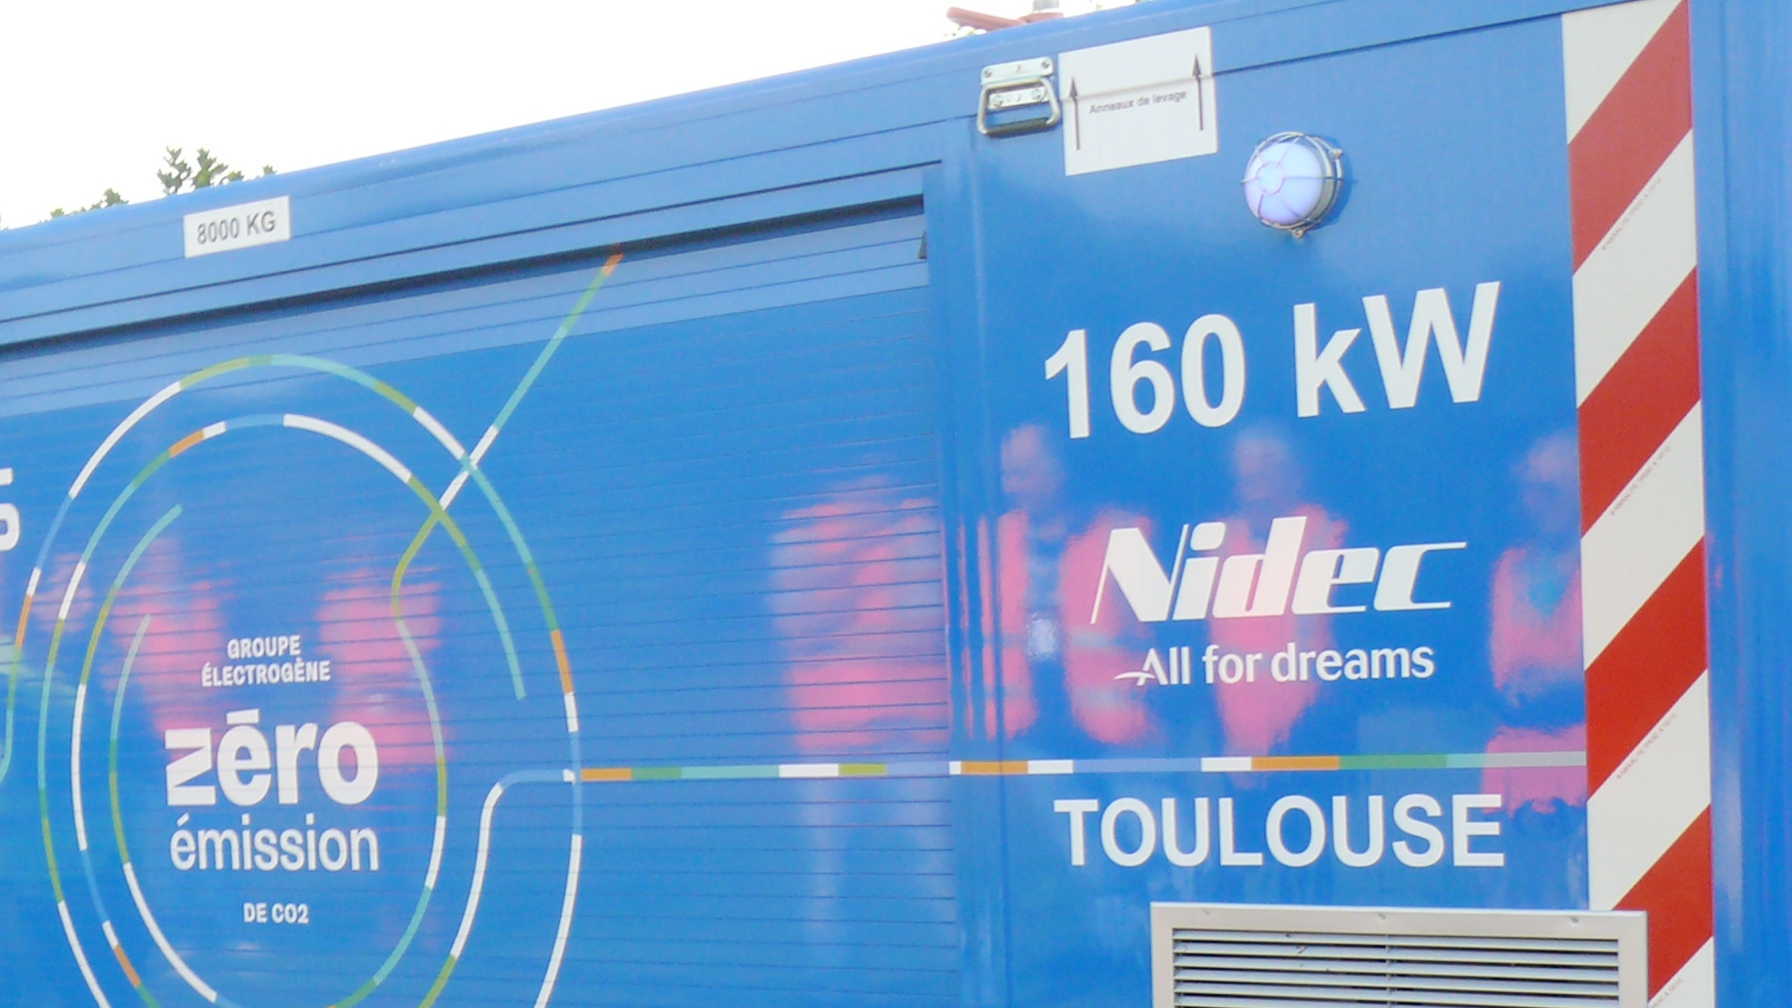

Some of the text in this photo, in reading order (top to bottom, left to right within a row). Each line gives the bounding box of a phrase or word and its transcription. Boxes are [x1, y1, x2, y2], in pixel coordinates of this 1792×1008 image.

[1136, 96, 1150, 106] de
[1152, 91, 1187, 104] levage
[197, 210, 276, 245] 8000 KG
[1045, 281, 1501, 440] 160 kW
[1090, 515, 1468, 625] Nidec
[226, 634, 302, 660] GROUPE
[1114, 642, 1436, 686] All for dreams
[201, 657, 331, 688] ÉLECTROGÈNE
[170, 812, 379, 872] émission
[1053, 793, 1505, 868] TOULOUSE
[243, 902, 310, 925] DE CO2
